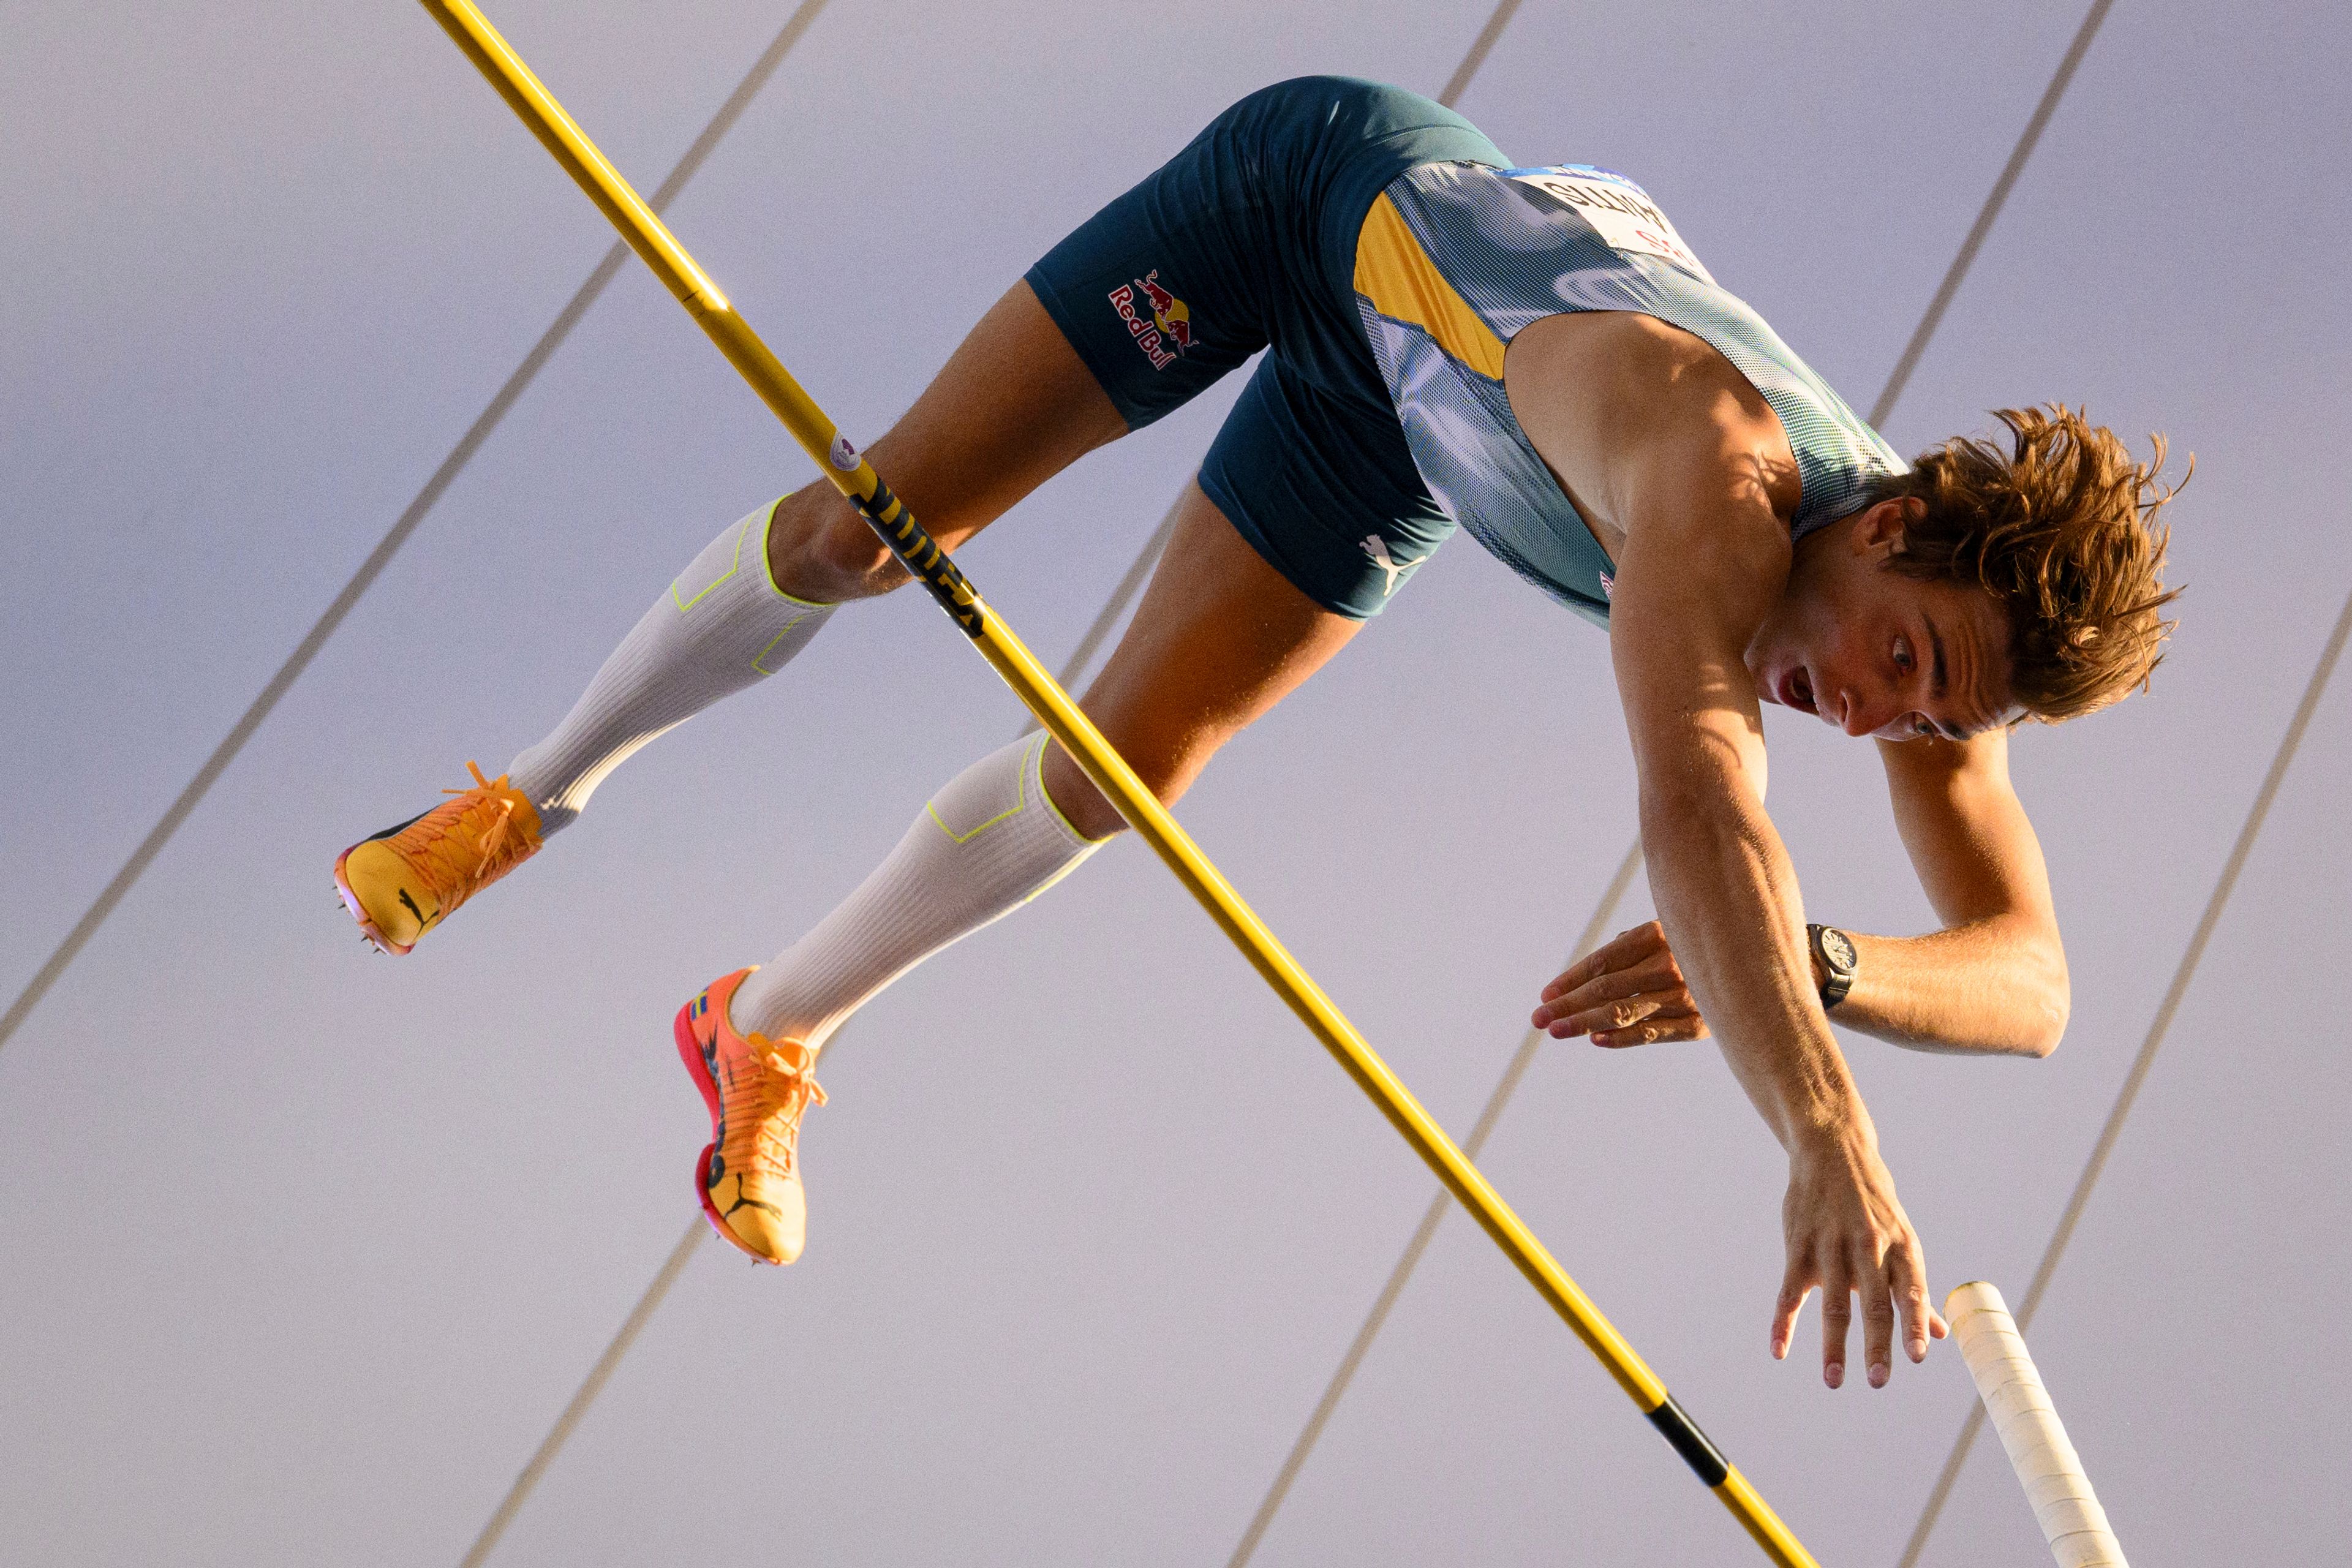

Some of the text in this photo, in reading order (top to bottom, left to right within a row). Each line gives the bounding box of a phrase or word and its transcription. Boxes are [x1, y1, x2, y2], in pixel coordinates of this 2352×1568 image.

[1544, 182, 1670, 234] ANTIS
[1108, 284, 1177, 371] Red Bull
